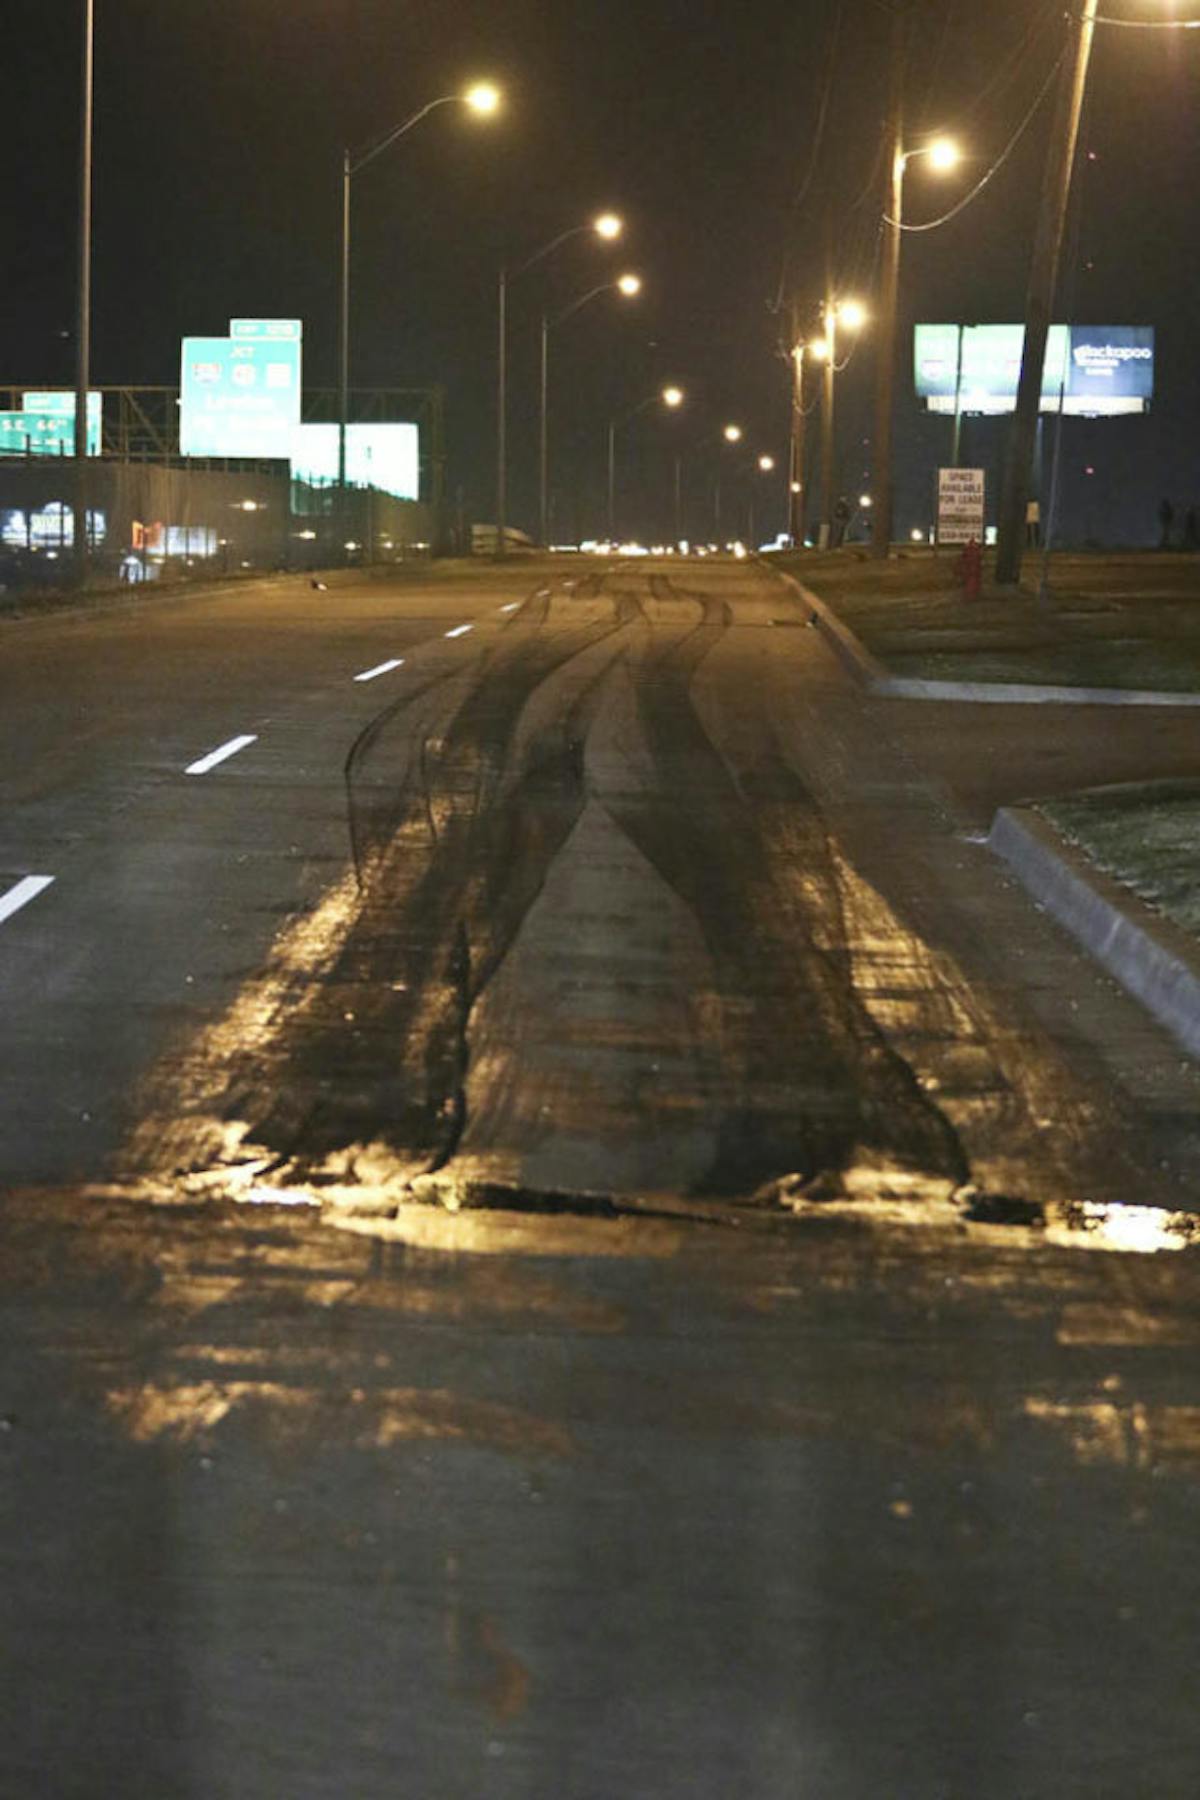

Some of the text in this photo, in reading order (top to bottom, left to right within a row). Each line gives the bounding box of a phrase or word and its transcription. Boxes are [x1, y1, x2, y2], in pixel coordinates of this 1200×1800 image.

[941, 483, 982, 494] AVAILABLE
[940, 494, 982, 505] FOR LEASE
